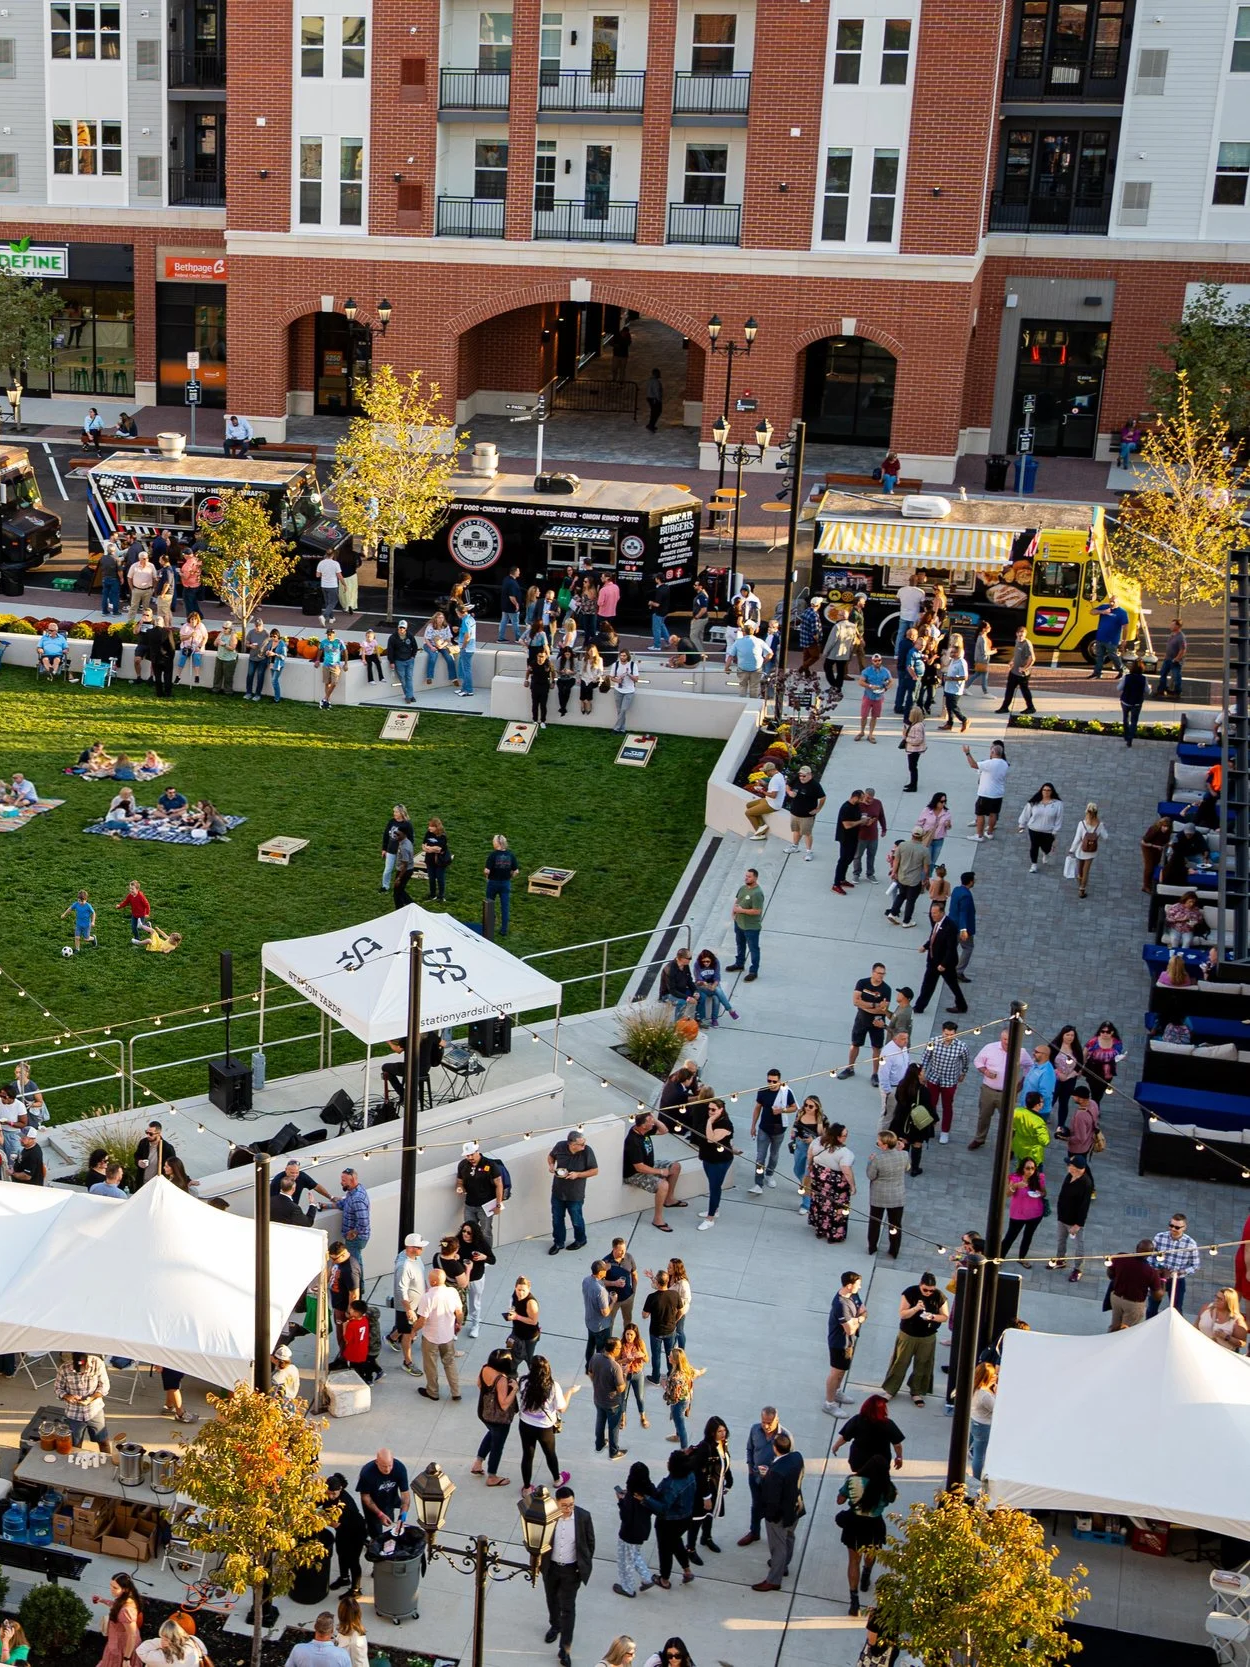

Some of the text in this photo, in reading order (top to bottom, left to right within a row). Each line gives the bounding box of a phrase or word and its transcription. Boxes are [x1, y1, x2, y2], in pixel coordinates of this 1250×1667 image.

[174, 262, 213, 274] Bethpage
[143, 483, 172, 491] BURGERS
[175, 486, 206, 494] BURRITOS
[463, 504, 480, 512] DOGS
[482, 505, 507, 513] CHICKEN
[510, 508, 534, 516] GRILLED
[535, 509, 558, 518] CHEESE
[559, 511, 578, 519] FRIES
[601, 514, 620, 522] RINGS
[623, 515, 640, 523] TOTS
[661, 511, 693, 525] BOXCAR
[543, 530, 612, 540] BURGERS
[551, 525, 610, 535] BOXCAR
[659, 520, 695, 536] BURGERS
[288, 970, 342, 1017] STION YARDS
[420, 1001, 513, 1028] stationyardsli.com
[359, 1326, 366, 1341] 7
